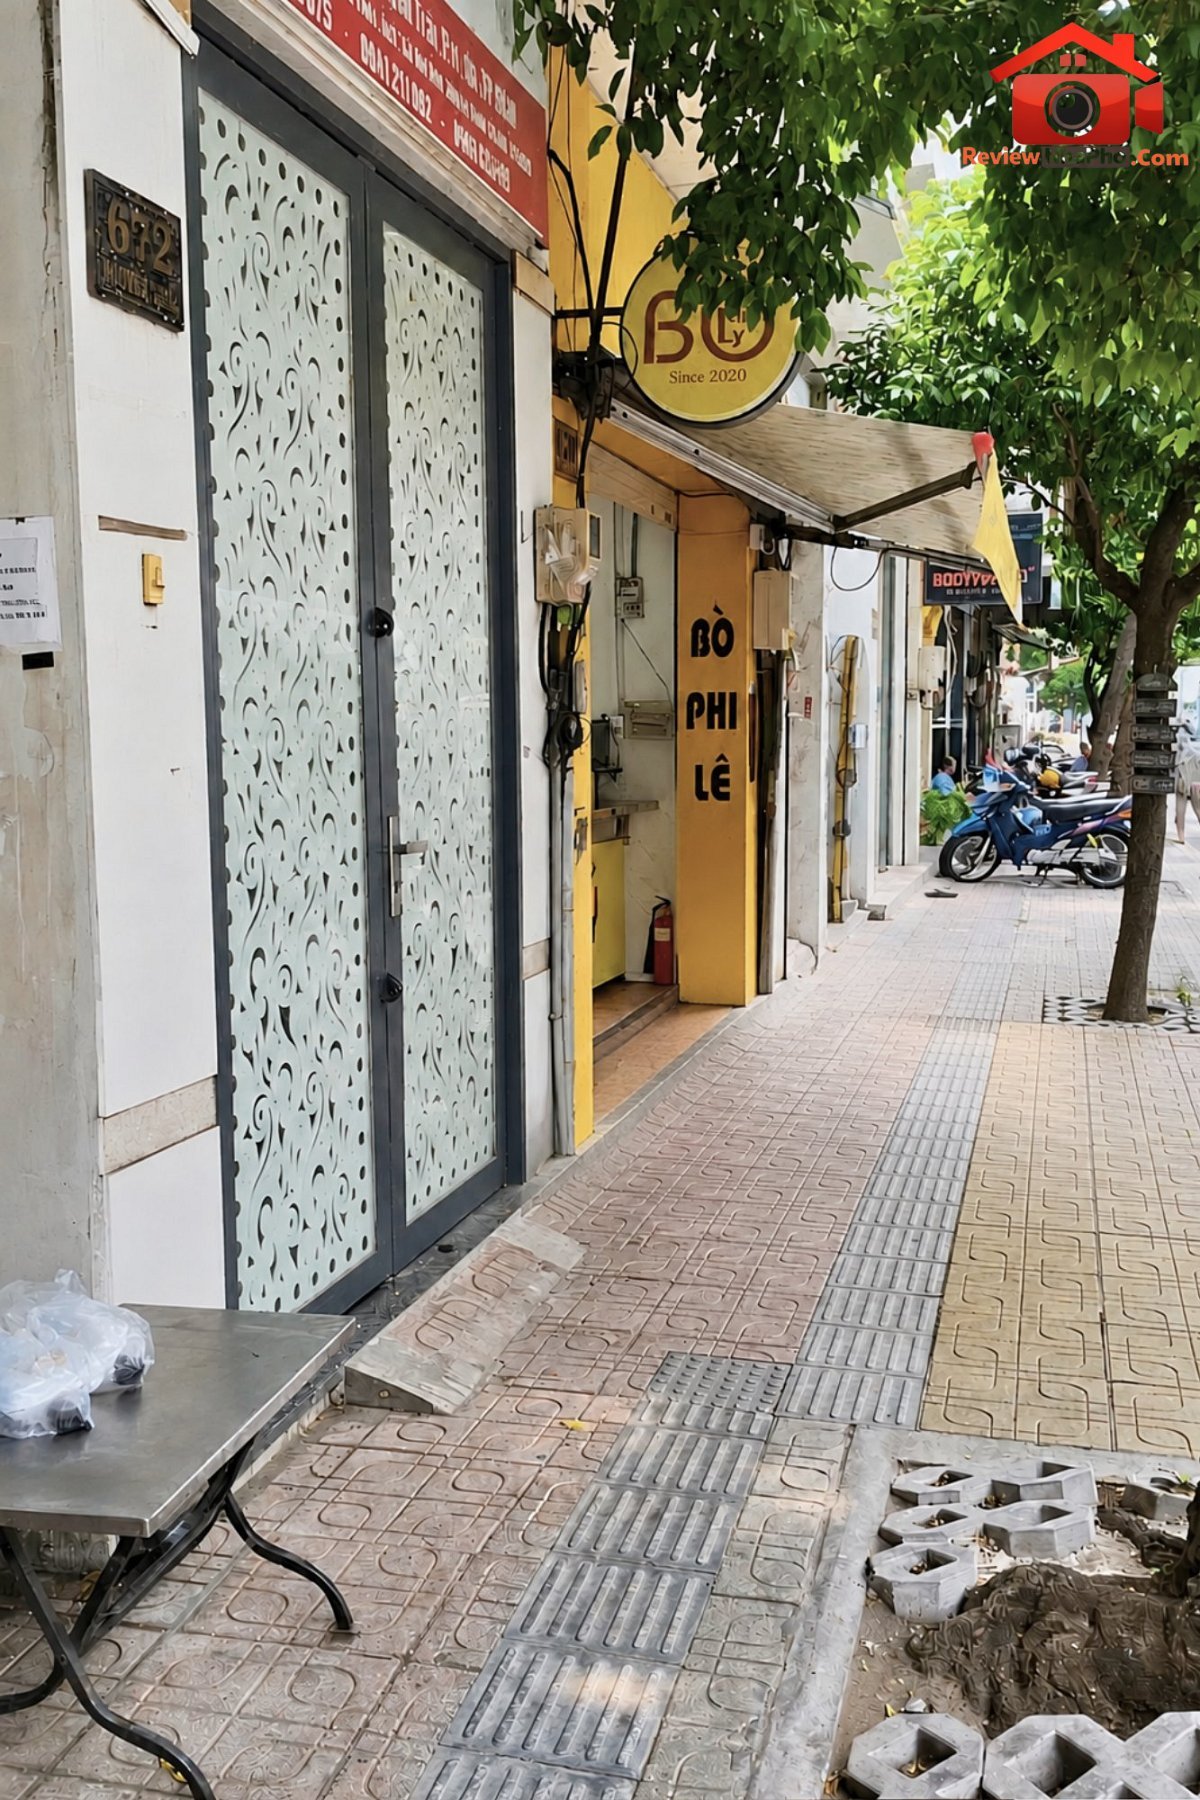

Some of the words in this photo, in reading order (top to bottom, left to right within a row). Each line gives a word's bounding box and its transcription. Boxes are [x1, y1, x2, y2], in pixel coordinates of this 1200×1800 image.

[107, 198, 174, 275] 672
[669, 370, 705, 384] Since
[709, 369, 747, 383] 2020
[690, 604, 735, 658] BÒ
[686, 691, 737, 730] PHI
[694, 753, 731, 801] LÊ
